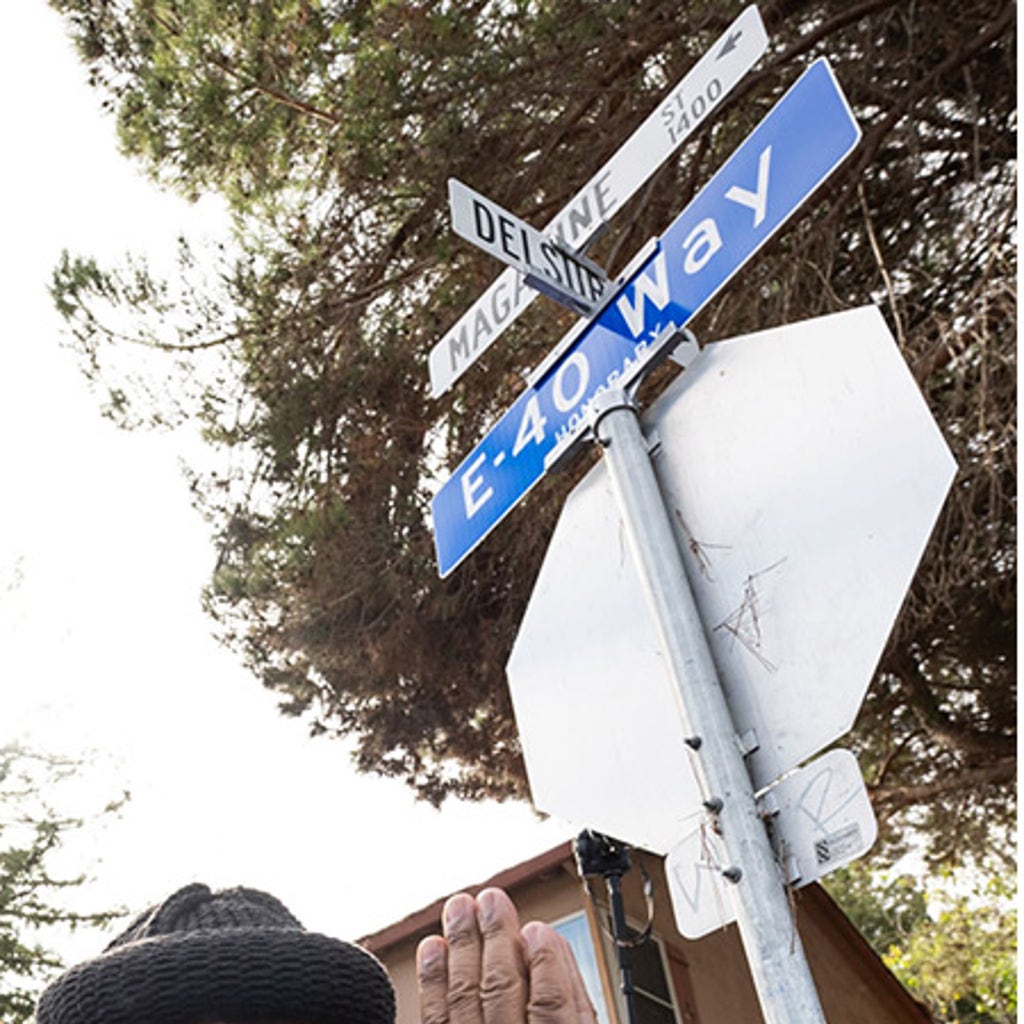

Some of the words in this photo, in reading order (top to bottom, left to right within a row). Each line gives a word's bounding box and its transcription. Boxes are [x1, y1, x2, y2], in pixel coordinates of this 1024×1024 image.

[661, 88, 684, 127] ST
[668, 79, 722, 144] 1400
[460, 351, 591, 520] E-40
[616, 145, 773, 338] Way
